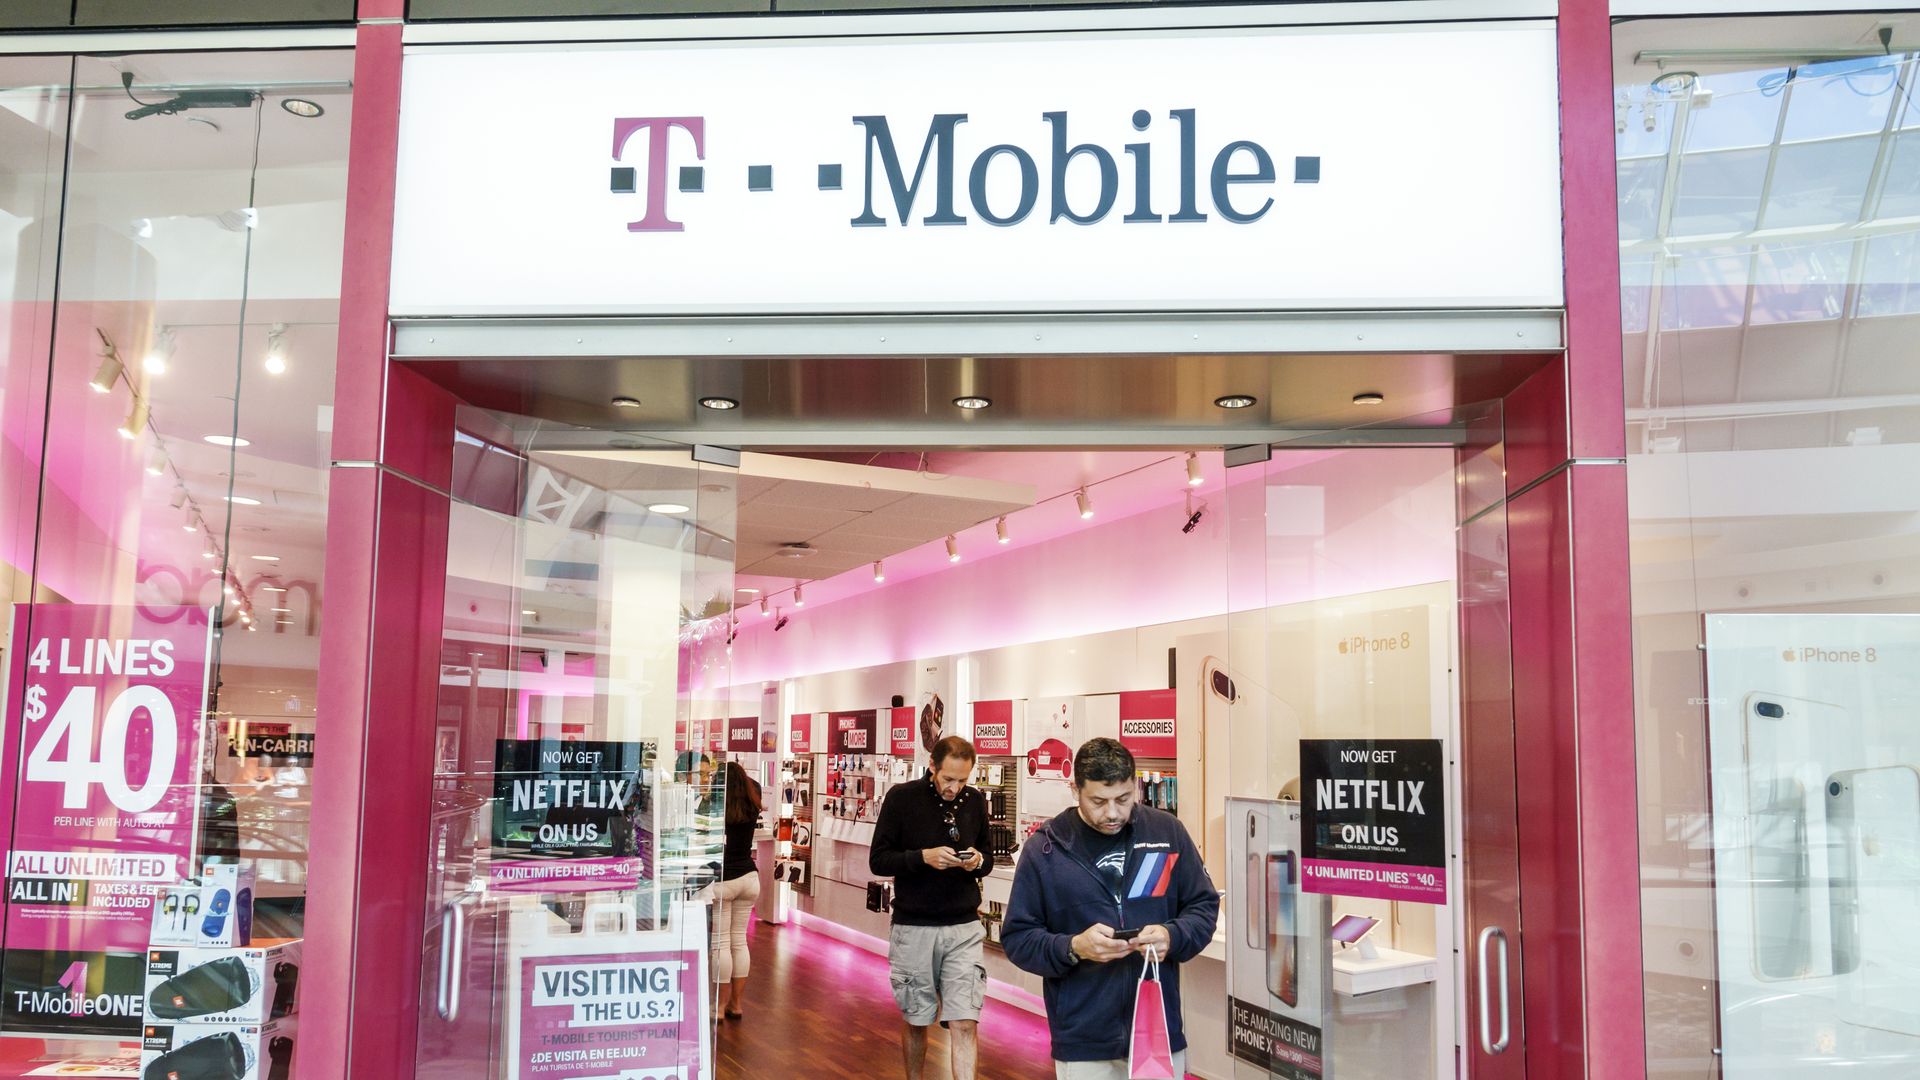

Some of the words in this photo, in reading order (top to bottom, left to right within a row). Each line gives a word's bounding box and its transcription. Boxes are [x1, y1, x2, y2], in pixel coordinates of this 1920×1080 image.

[850, 108, 1276, 228] Mobile
[1350, 634, 1397, 654] iPhone
[1400, 632, 1410, 650] 8
[29, 638, 50, 674] 4
[59, 638, 175, 677] LINES
[1799, 648, 1860, 663] iPhone
[1865, 648, 1877, 663] 8
[731, 728, 754, 741] SAMSUNG
[893, 729, 907, 739] AUDIO
[976, 725, 1006, 738] CHARGING
[1123, 721, 1173, 735] ACCESSORIES
[849, 731, 866, 747] MORE
[980, 740, 1008, 750] ACCESSORIES
[543, 751, 573, 764] NOW
[575, 751, 600, 764] GET
[1341, 750, 1370, 763] NOW
[1372, 750, 1396, 763] GET
[513, 779, 626, 812] NETFLIX
[1316, 779, 1425, 815] NETFLIX
[53, 816, 72, 827] PER
[74, 817, 95, 827] LINE
[97, 817, 121, 827] WITH
[539, 823, 568, 843] ON
[572, 823, 598, 841] US
[1342, 824, 1368, 844] ON
[1373, 826, 1399, 846] US
[15, 856, 49, 874] ALL
[54, 857, 165, 877] UNLIMITED
[496, 869, 504, 880] 4
[506, 866, 570, 880] UNLIMITED
[573, 864, 605, 876] LINES
[1307, 865, 1313, 877] 4
[1315, 866, 1374, 881] UNLIMITED
[1376, 871, 1409, 884] LINES
[1417, 873, 1435, 886] $40
[12, 881, 48, 900] ALL
[52, 882, 79, 902] IN!
[95, 884, 128, 895] TAXES
[131, 885, 137, 895] &
[141, 885, 159, 895] FEE
[93, 896, 150, 908] INCLUDED
[542, 967, 670, 997] VISITING
[582, 1002, 622, 1022] THE
[626, 1000, 675, 1020] U.S.?
[541, 1032, 594, 1045] T-MOBILE
[597, 1029, 646, 1043] TOURIST
[647, 1027, 676, 1040] PLAN
[1233, 1006, 1249, 1025] THE
[1250, 1012, 1291, 1042] AMAZING
[1293, 1028, 1316, 1051] NEW
[1266, 1038, 1273, 1055] X
[531, 1052, 552, 1064] ¿DE
[554, 1051, 588, 1062] VISITA
[590, 1049, 604, 1060] EN
[606, 1047, 647, 1058] EE.UU.?
[550, 1063, 574, 1071] TURISTA
[575, 1062, 584, 1070] DE
[585, 1061, 613, 1069] T-MOBILE
